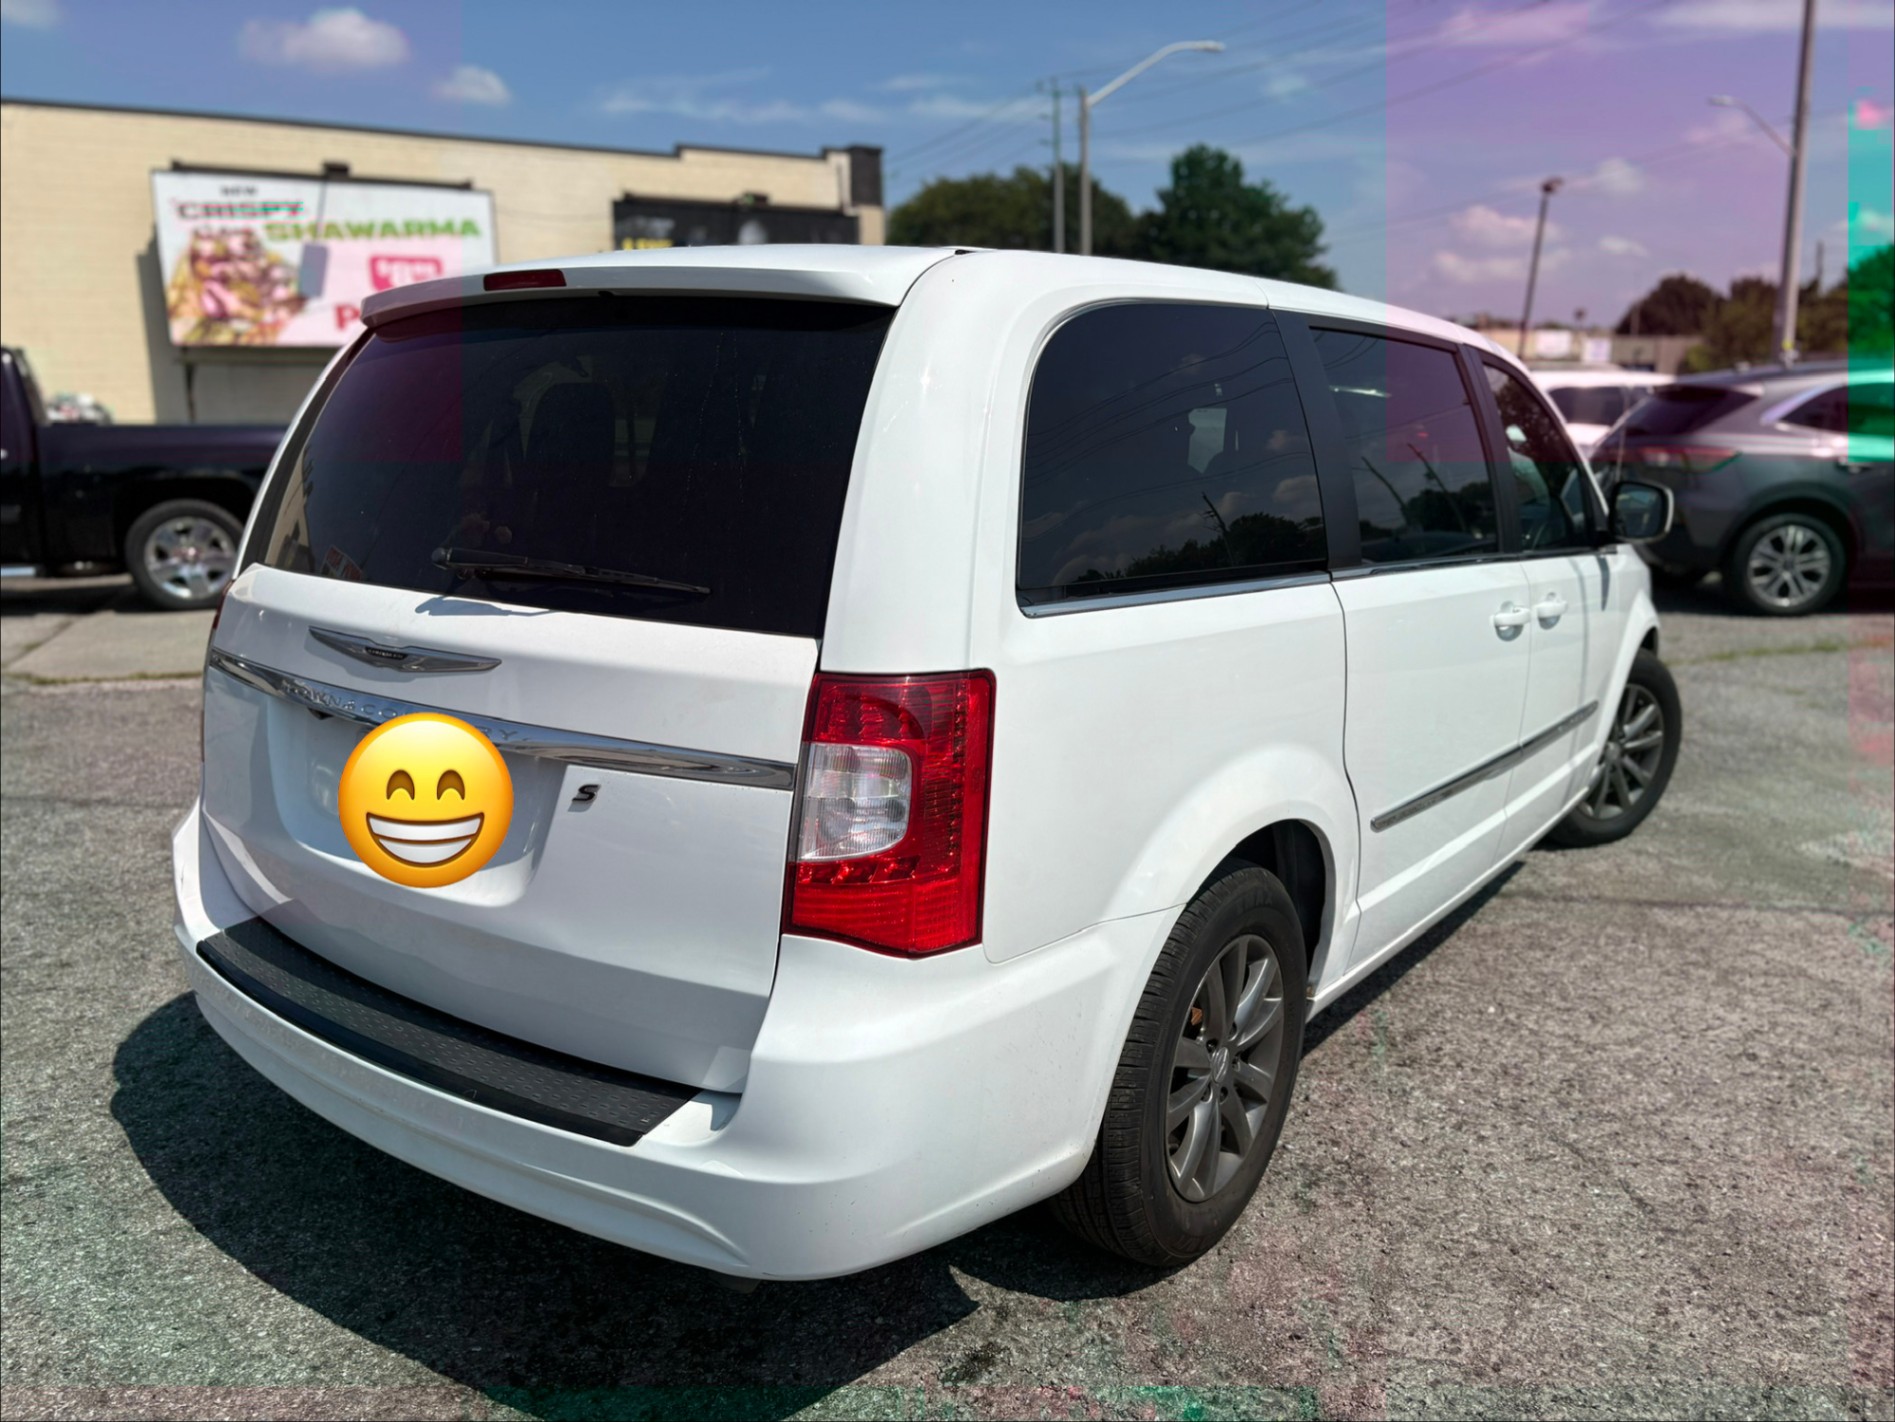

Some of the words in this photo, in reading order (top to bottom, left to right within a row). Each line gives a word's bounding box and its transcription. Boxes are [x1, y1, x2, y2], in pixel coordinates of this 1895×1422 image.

[177, 201, 303, 220] CRISPY
[265, 219, 481, 240] SHAWARMA
[572, 784, 600, 803] S
